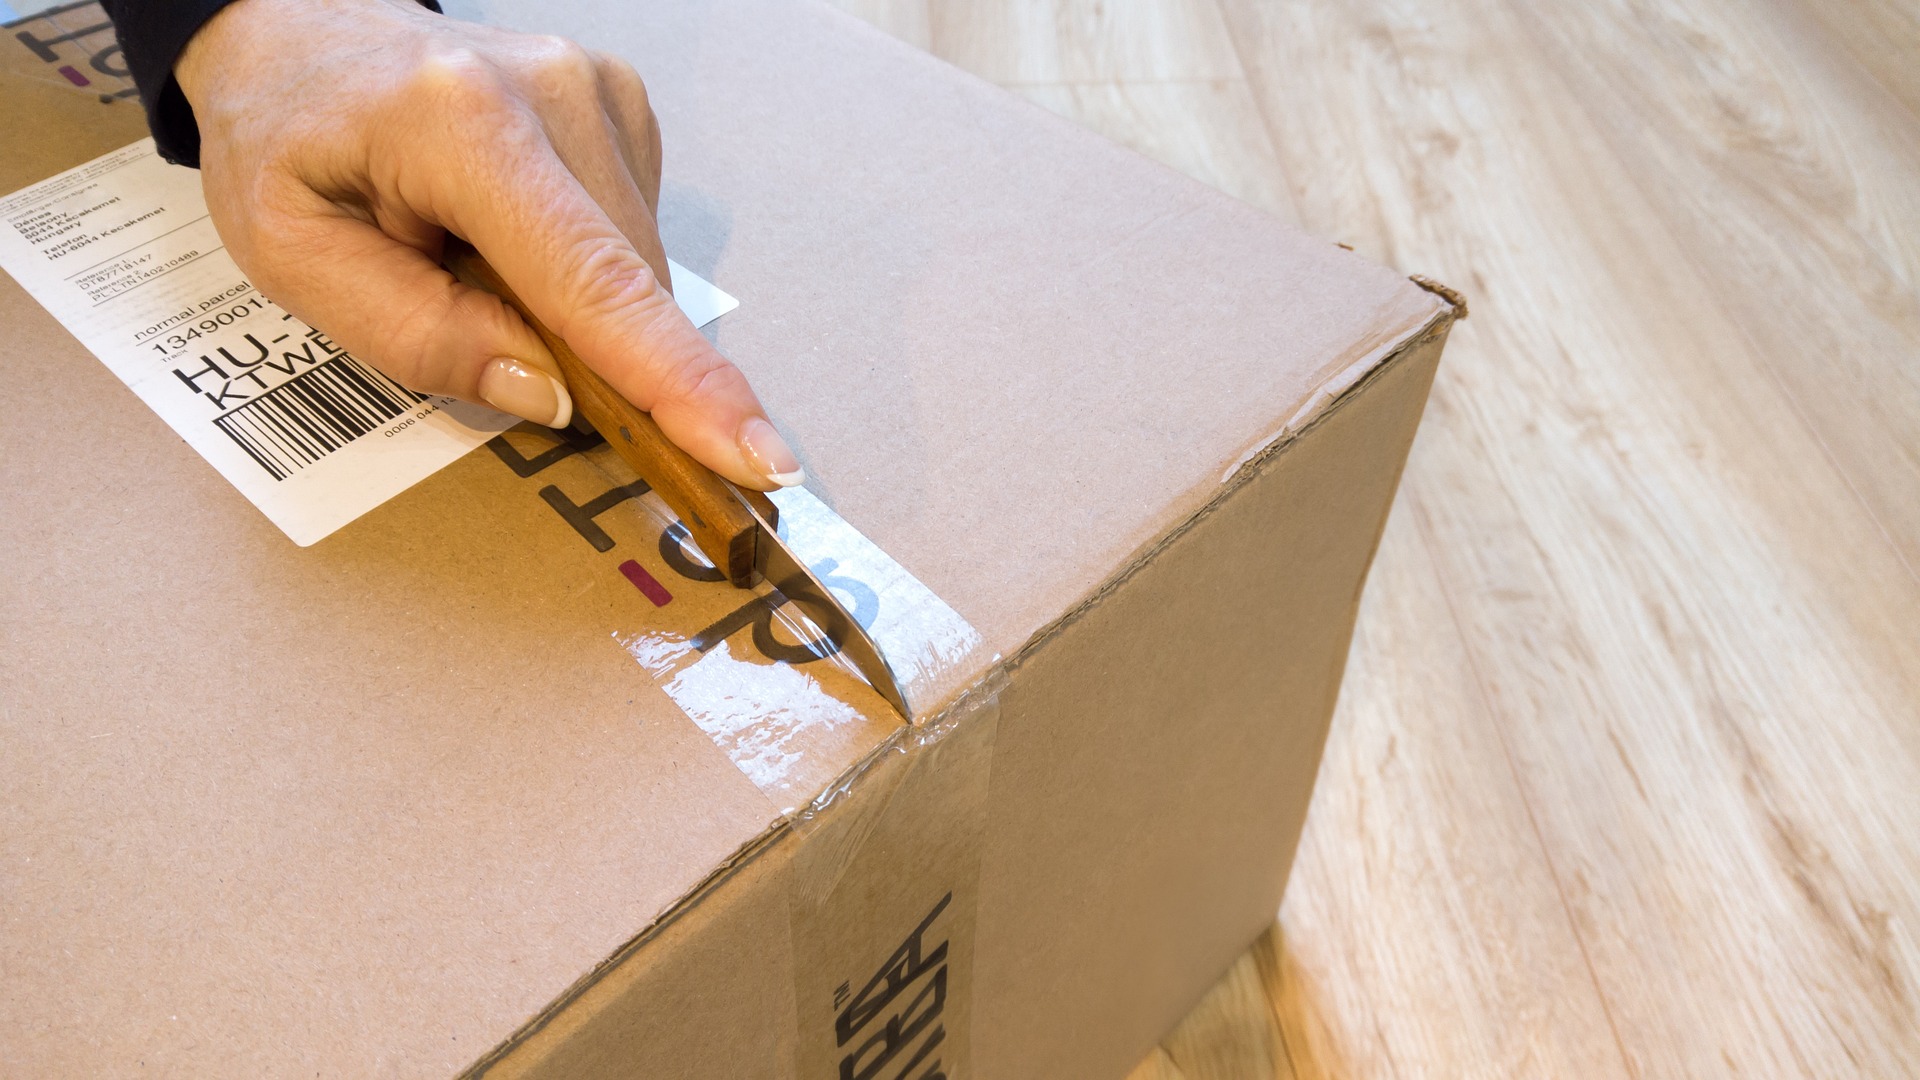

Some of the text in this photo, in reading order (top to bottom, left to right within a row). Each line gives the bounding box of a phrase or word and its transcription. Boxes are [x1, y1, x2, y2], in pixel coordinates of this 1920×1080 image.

[25, 224, 54, 240] 6044
[30, 220, 82, 246] Hungary
[42, 233, 87, 255] Telefon
[47, 236, 99, 261] HU-6044
[75, 263, 119, 285] Reference
[87, 275, 132, 297] Reference
[134, 280, 251, 340] normal parcel
[161, 349, 188, 364] Track
[384, 418, 416, 438] 0006
[416, 405, 439, 420] 044
